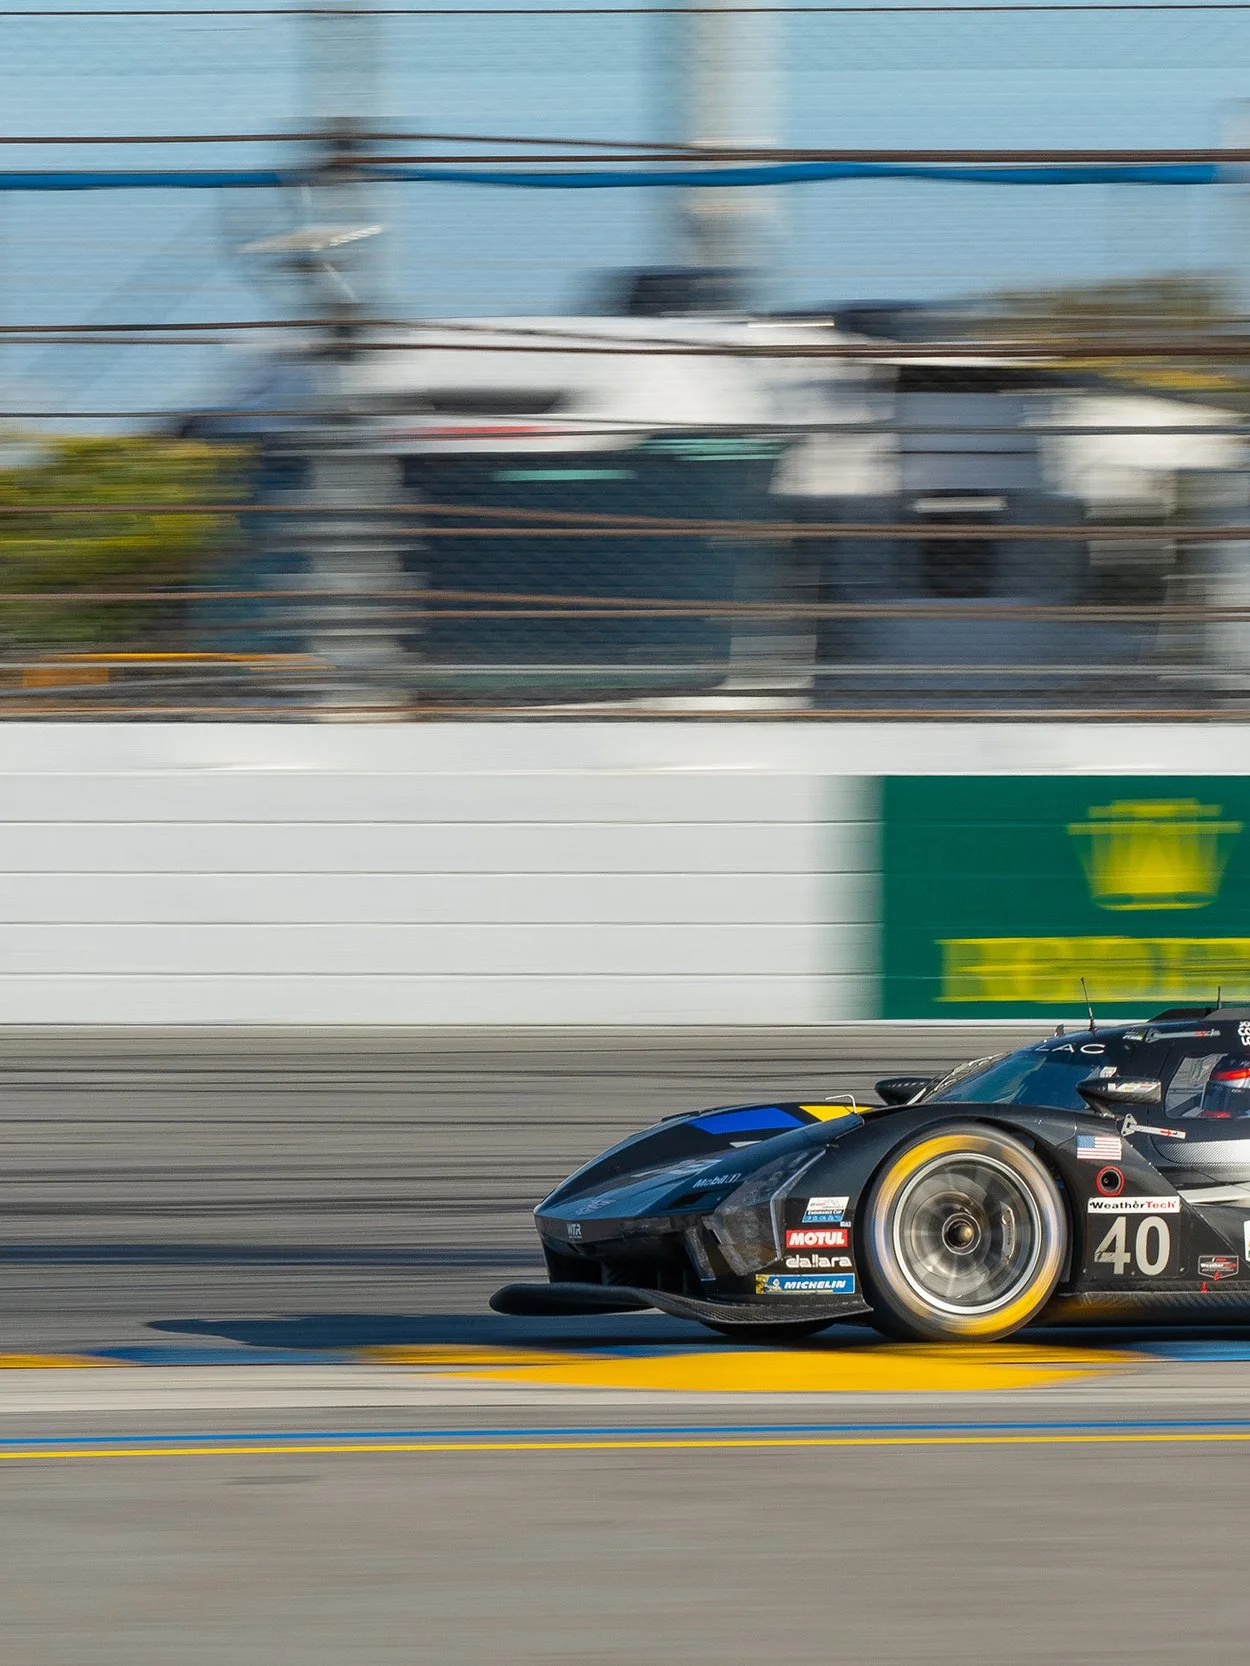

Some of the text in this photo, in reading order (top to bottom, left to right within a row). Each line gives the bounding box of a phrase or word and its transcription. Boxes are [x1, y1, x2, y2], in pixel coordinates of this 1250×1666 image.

[1089, 1200, 1177, 1210] WeatherTech
[567, 1223, 582, 1236] WTR
[789, 1232, 845, 1245] MOTUL
[1093, 1215, 1171, 1276] 40
[785, 1254, 853, 1268] dallara
[784, 1280, 847, 1289] MICHELIN
